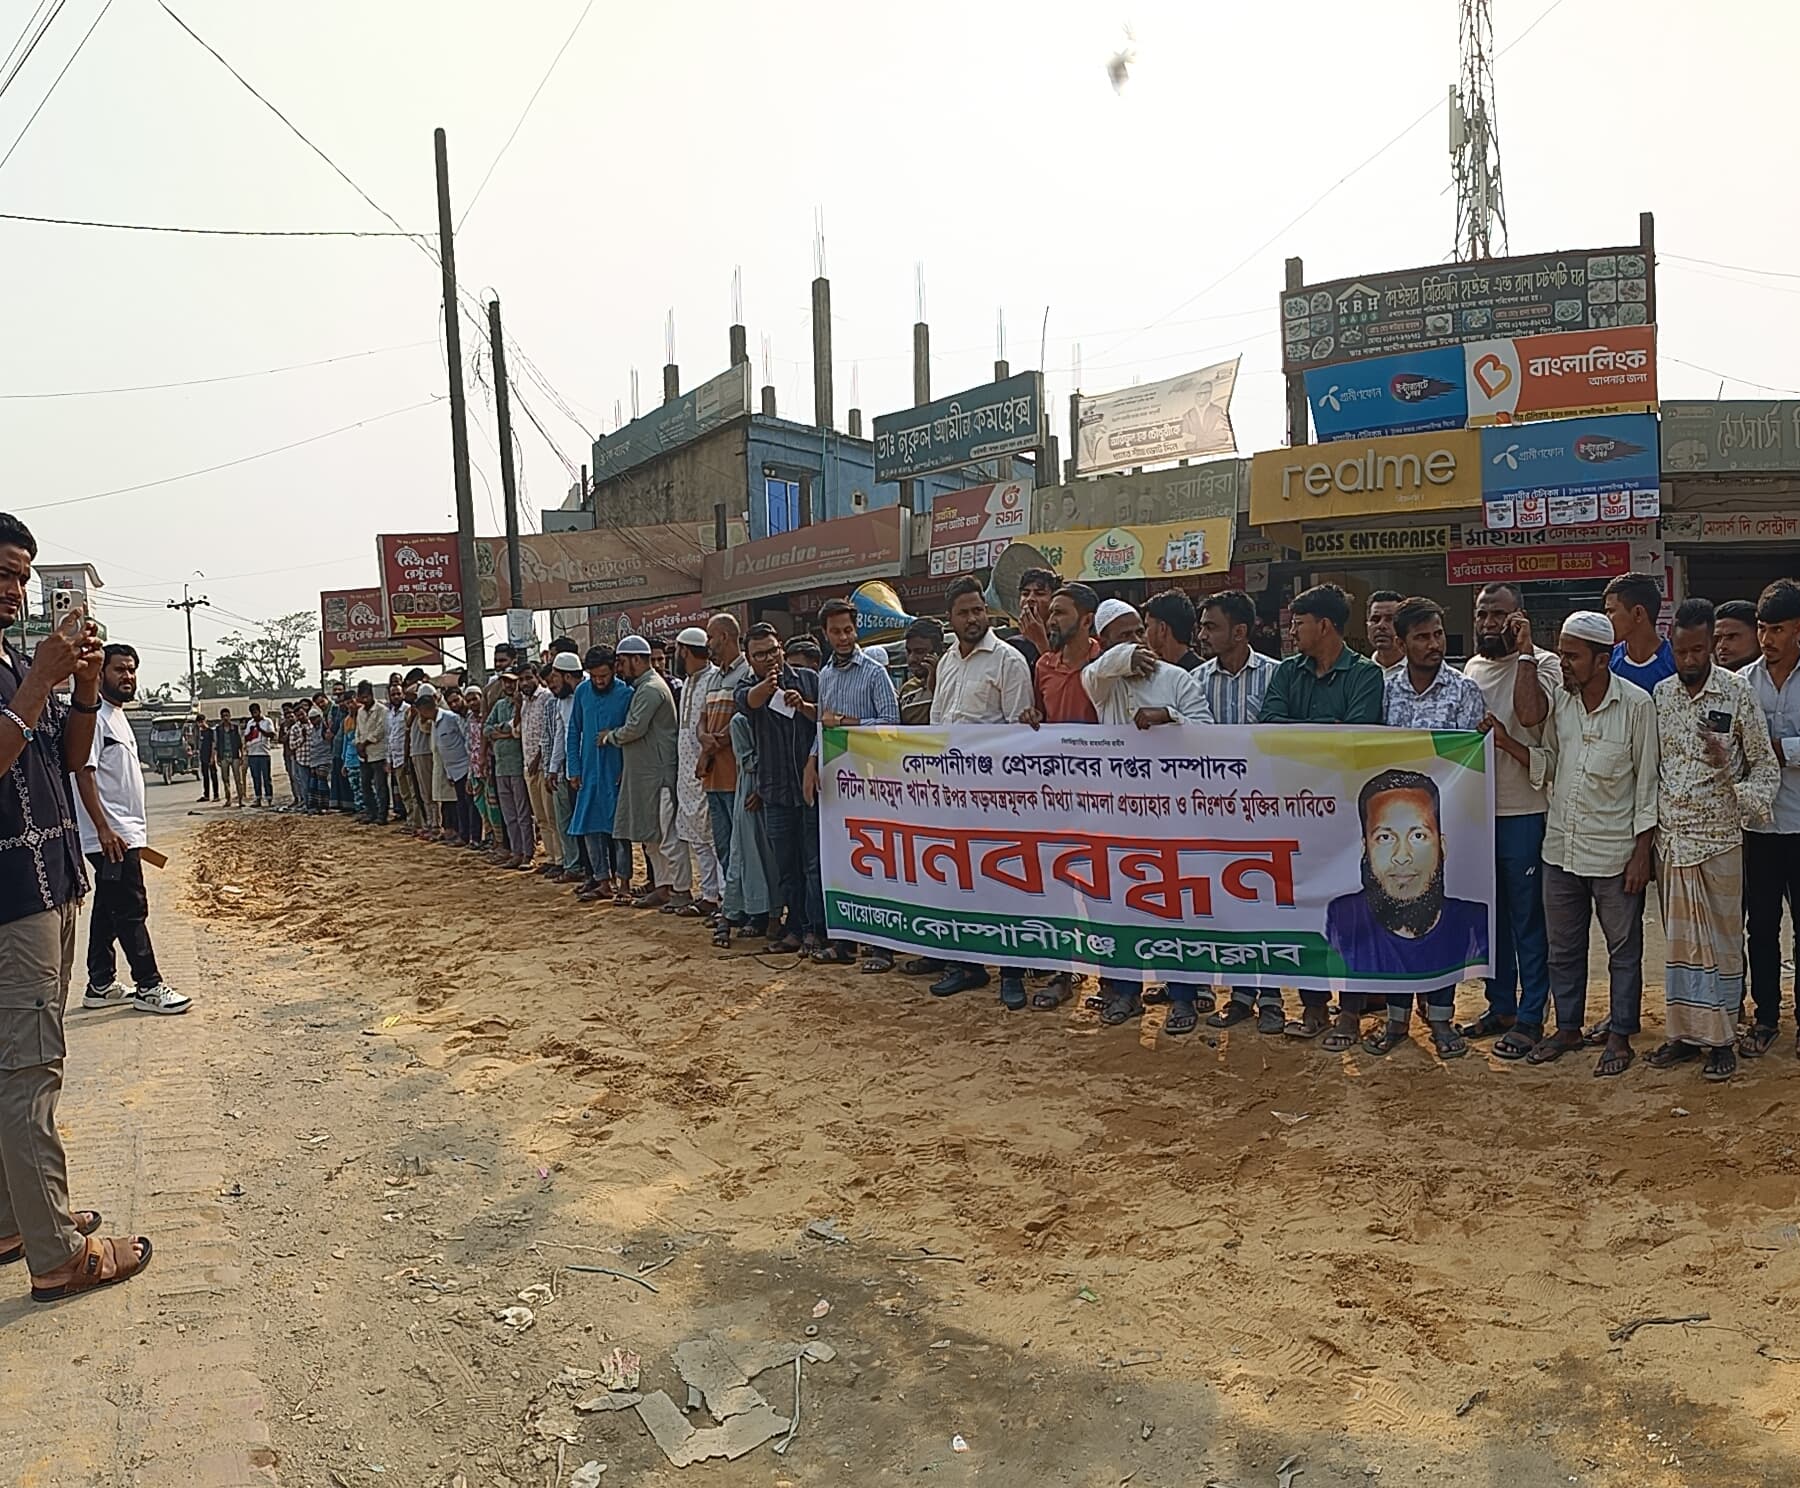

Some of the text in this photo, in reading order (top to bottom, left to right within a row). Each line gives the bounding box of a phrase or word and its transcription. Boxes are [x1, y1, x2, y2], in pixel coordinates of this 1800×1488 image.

[1536, 261, 1568, 290] চটপটি
[1570, 269, 1585, 287] ঘর
[1529, 345, 1648, 377] বাংলালিংক
[876, 430, 896, 460] ডাঃ
[1717, 403, 1782, 457] মেসার্স
[1281, 448, 1457, 500] realme
[995, 509, 1024, 525] নগদ
[1520, 512, 1543, 523] নগদ
[1603, 505, 1628, 516] নগদ
[1703, 515, 1735, 535] মেসার্স
[1738, 514, 1751, 534] দি
[1755, 515, 1798, 536] সেন্ট্রাল
[1305, 533, 1345, 553] BOSS
[1350, 528, 1446, 550] ENTERPRISE
[903, 748, 1248, 780] কোম্পানীগঞ্জ প্রেসক্লাবের দপ্তর সম্পাদক
[837, 769, 865, 800] লিটন
[868, 777, 903, 811] মাহমুদ
[943, 782, 968, 809] উপর
[970, 789, 1038, 817] ষড়যন্ত্রমূলক
[1041, 784, 1072, 813] মিথ্যা
[1077, 791, 1114, 815] মামলা
[1118, 793, 1171, 819] প্রত্যাহার
[1176, 796, 1187, 816] ও
[1191, 788, 1238, 818] নিঃশর্ত
[1242, 790, 1279, 823] মুক্তির
[1284, 789, 1336, 818] দাবিতে
[844, 818, 1301, 922] মানববন্ধন
[911, 915, 1118, 959] কোম্পানীগঞ্জ
[1134, 936, 1307, 969] প্রেসক্লাব
